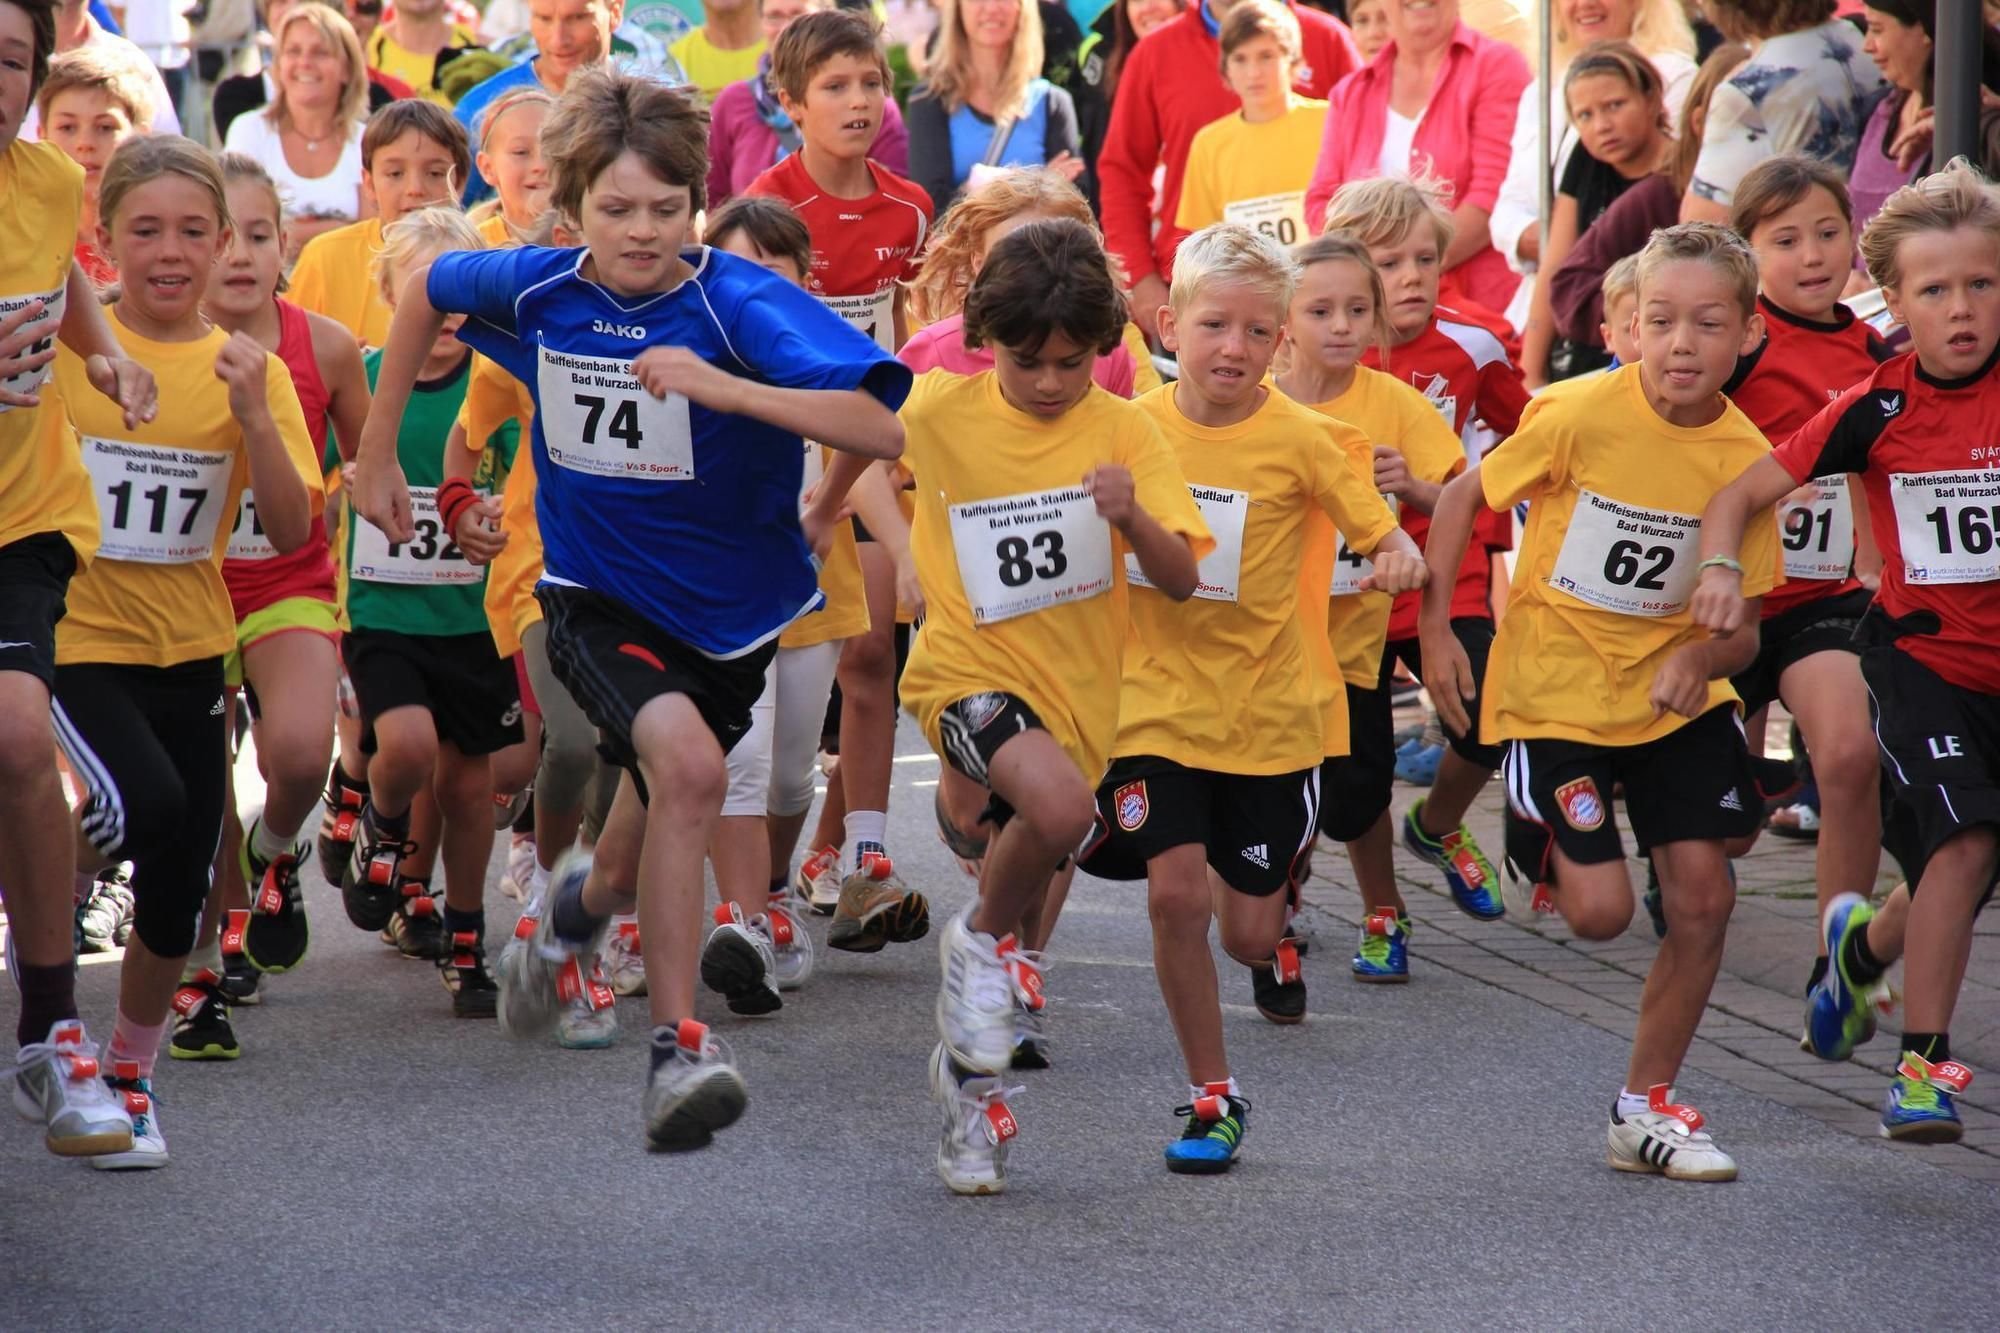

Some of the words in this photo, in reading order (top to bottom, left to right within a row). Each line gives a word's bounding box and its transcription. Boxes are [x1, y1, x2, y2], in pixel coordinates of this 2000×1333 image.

[592, 319, 647, 340] JAKO
[545, 352, 621, 374] Raiffeisenbank
[571, 372, 591, 386] Bad
[594, 375, 642, 391] Wurzach
[574, 393, 643, 449] 74
[95, 441, 178, 463] Raiffeisenbank
[1971, 448, 1986, 461] SV
[126, 461, 147, 473] Bad
[150, 464, 199, 479] Wurzach
[1902, 473, 1981, 487] Raiffeisenbank
[1935, 488, 1955, 498] Bad
[107, 480, 208, 535] 117
[960, 498, 1038, 518] Raiffeisenbank
[1591, 496, 1669, 524] Raiffeisenbank
[989, 517, 1010, 530] Bad
[1013, 508, 1062, 525] Wurzach
[1617, 519, 1637, 532] Bad
[1640, 525, 1684, 540] Wurzach
[1782, 507, 1833, 552] 91
[996, 530, 1068, 587] 83
[1604, 539, 1675, 591] 62
[1928, 736, 1964, 759] LE
[1241, 850, 1270, 870] adidas
[265, 889, 280, 910] 101
[1939, 1065, 1966, 1080] 165
[1680, 1108, 1698, 1122] 62
[999, 1117, 1014, 1136] 83
